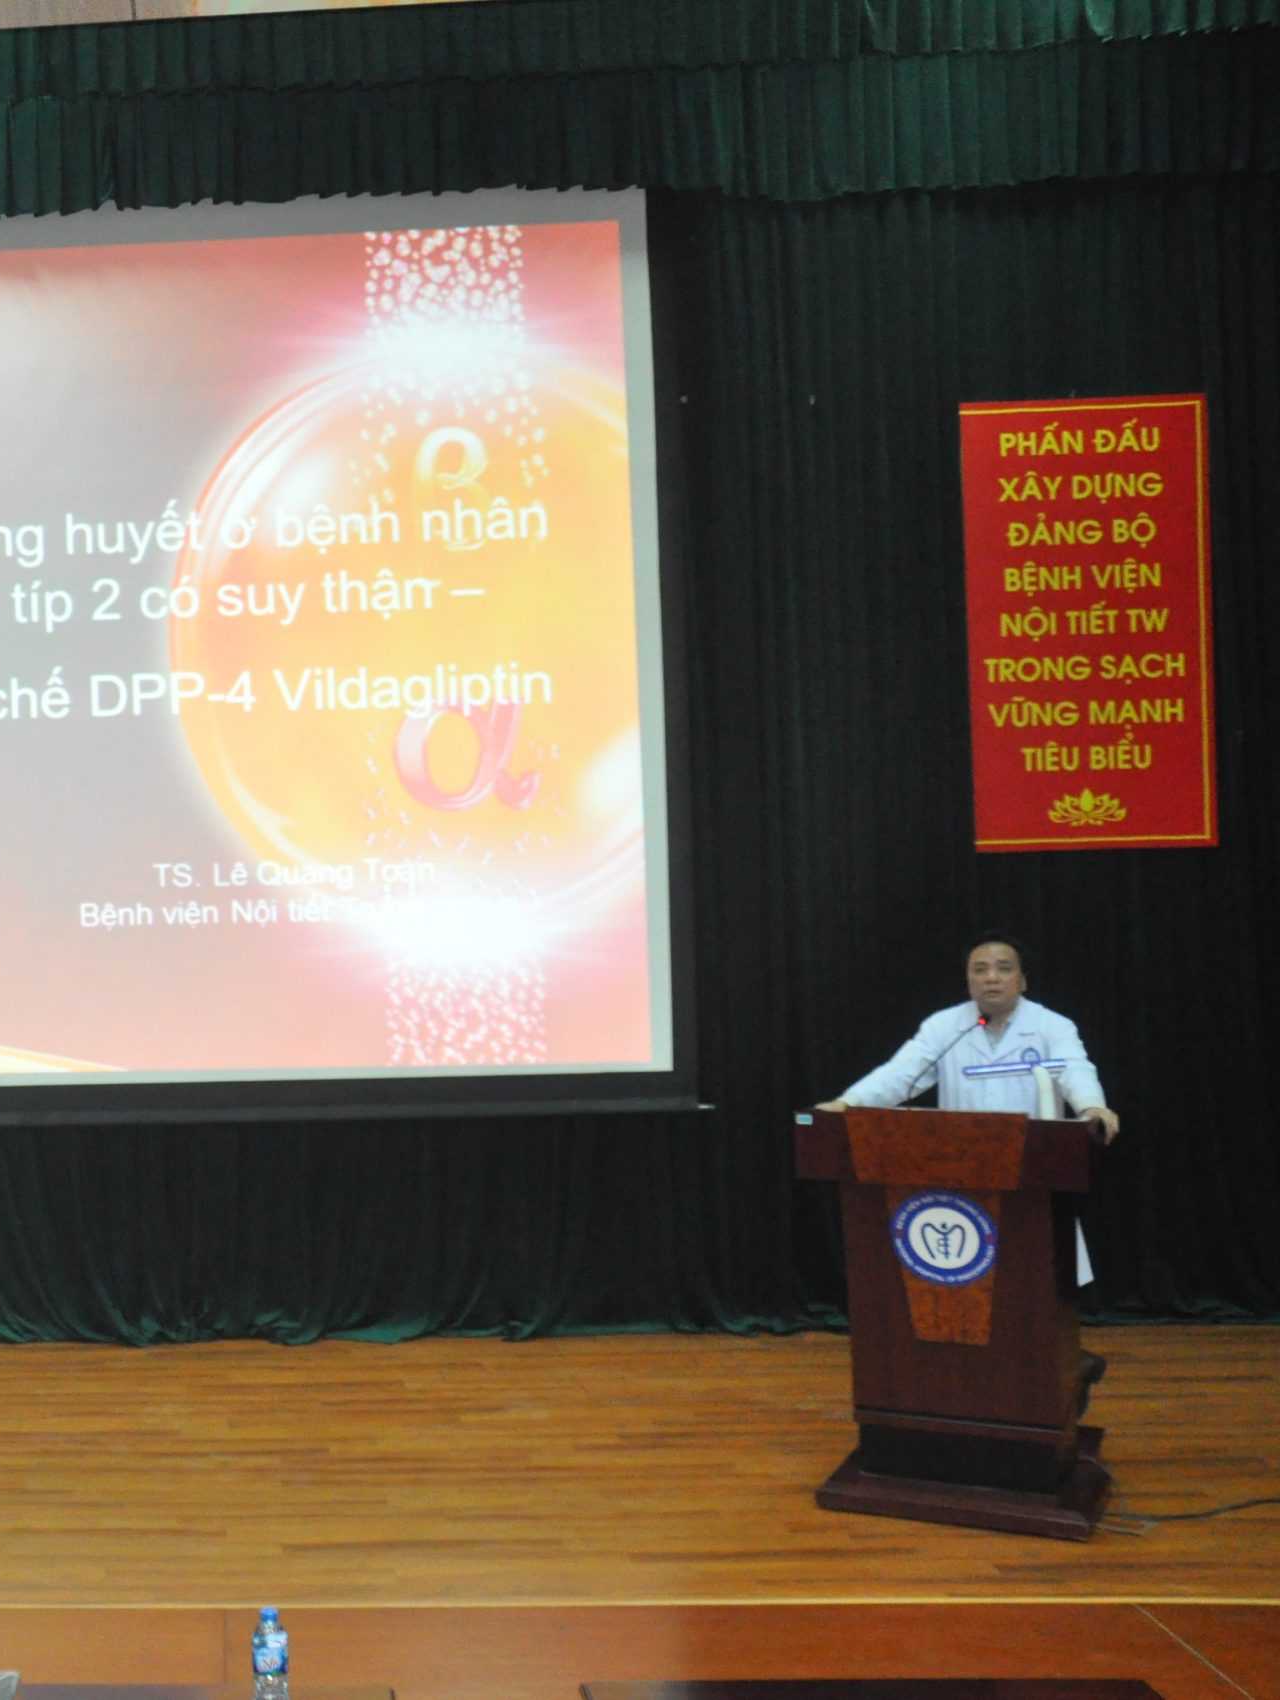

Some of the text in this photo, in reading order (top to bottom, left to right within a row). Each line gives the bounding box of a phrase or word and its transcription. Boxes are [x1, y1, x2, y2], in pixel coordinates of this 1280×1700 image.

[999, 418, 1160, 456] PHẤN ĐẤU
[998, 471, 1163, 504] XÂY DỰNG
[64, 499, 203, 564] huyết
[275, 500, 400, 553] bệnh
[421, 497, 549, 542] nhân
[1006, 512, 1157, 548] ĐẢNG BỘ
[1004, 558, 1161, 596] BỆNH VIỆN
[10, 581, 73, 633] típ
[91, 578, 121, 621] 2
[140, 574, 199, 619] có
[217, 581, 305, 625] suy
[322, 567, 434, 619] thận
[1000, 601, 1169, 642] NỘI TIẾT TW
[983, 653, 1185, 684] TRONG SẠCH
[91, 670, 256, 717] DPP-4
[273, 663, 552, 716] Vildagliptin
[988, 696, 1184, 730] VỮNG MẠNH
[1021, 732, 1152, 772] TIÊU BIỂU
[154, 863, 201, 887] TS.
[213, 861, 248, 887] Lê
[257, 861, 354, 890] Quang
[80, 901, 152, 931] Bệnh
[162, 901, 218, 929] viện
[231, 899, 277, 928] Nội
